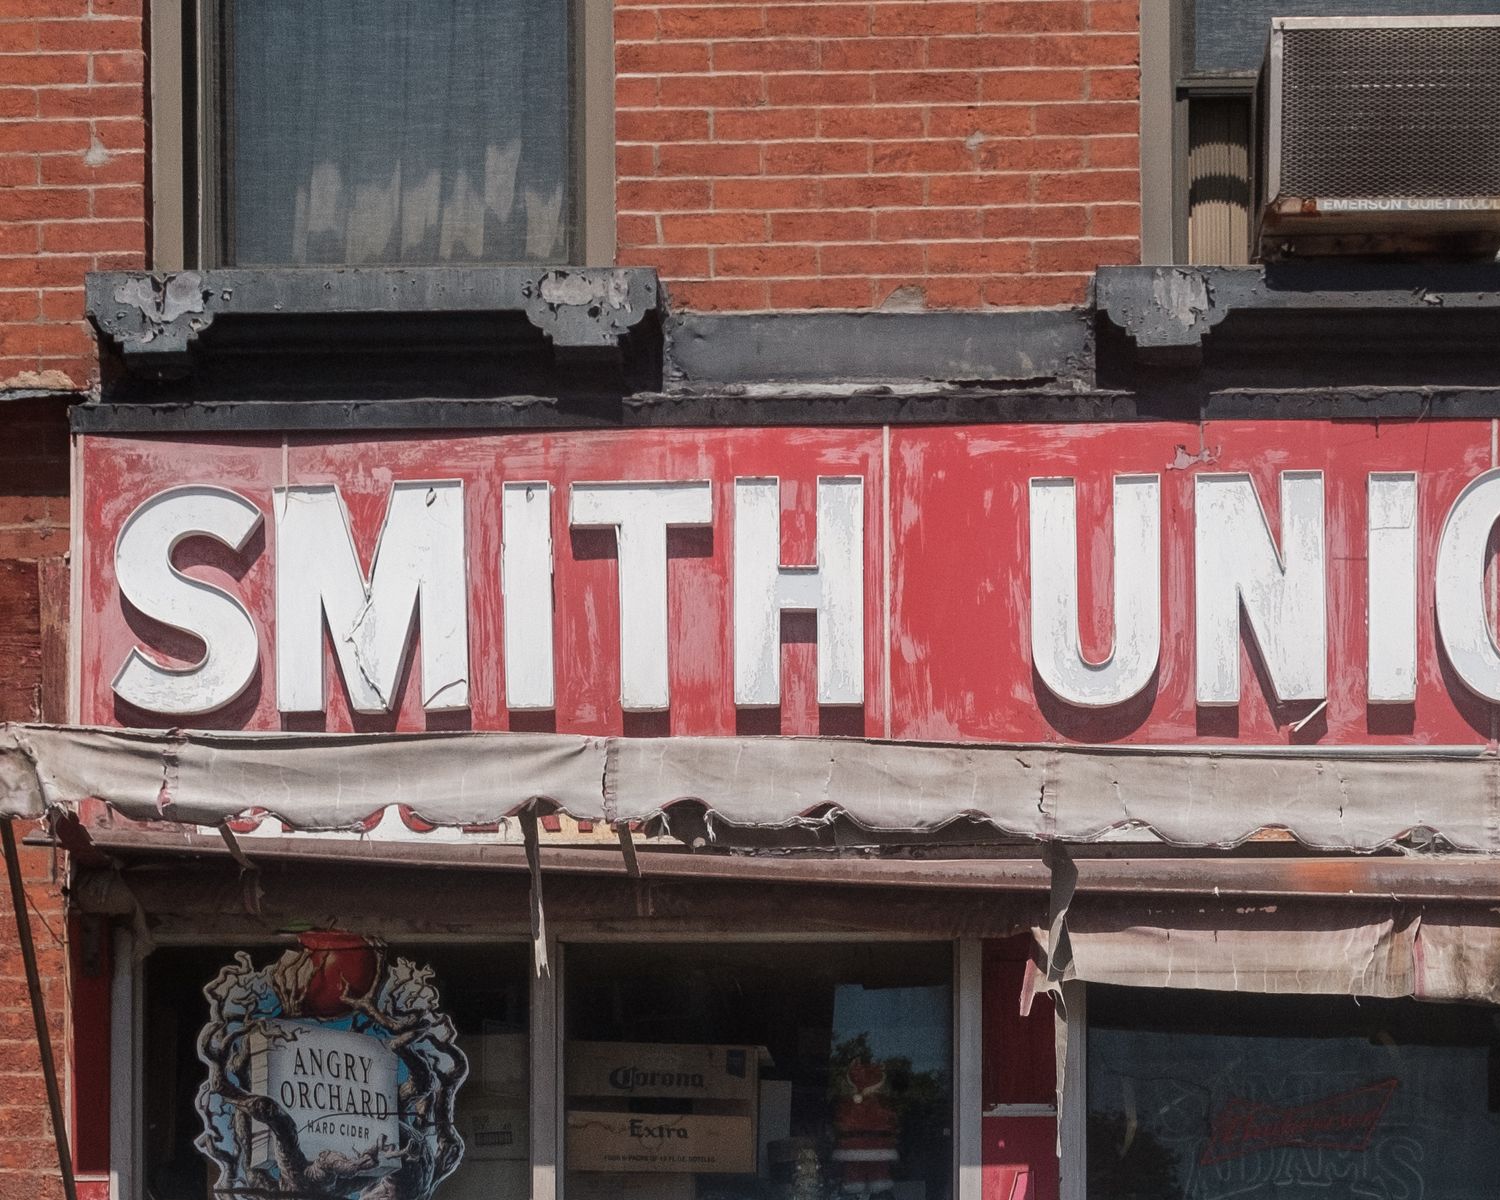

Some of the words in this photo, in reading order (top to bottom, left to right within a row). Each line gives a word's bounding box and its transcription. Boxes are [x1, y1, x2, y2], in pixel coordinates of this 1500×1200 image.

[1323, 199, 1401, 210] EMERSON
[1407, 199, 1451, 210] QUIET
[112, 475, 865, 715] SMITH
[293, 1048, 374, 1084] ANGRY
[609, 1065, 704, 1092] Corona
[281, 1080, 388, 1121] ORCHARD
[307, 1119, 336, 1134] HARD
[340, 1123, 369, 1141] CIDER
[629, 1119, 688, 1139] Extra
